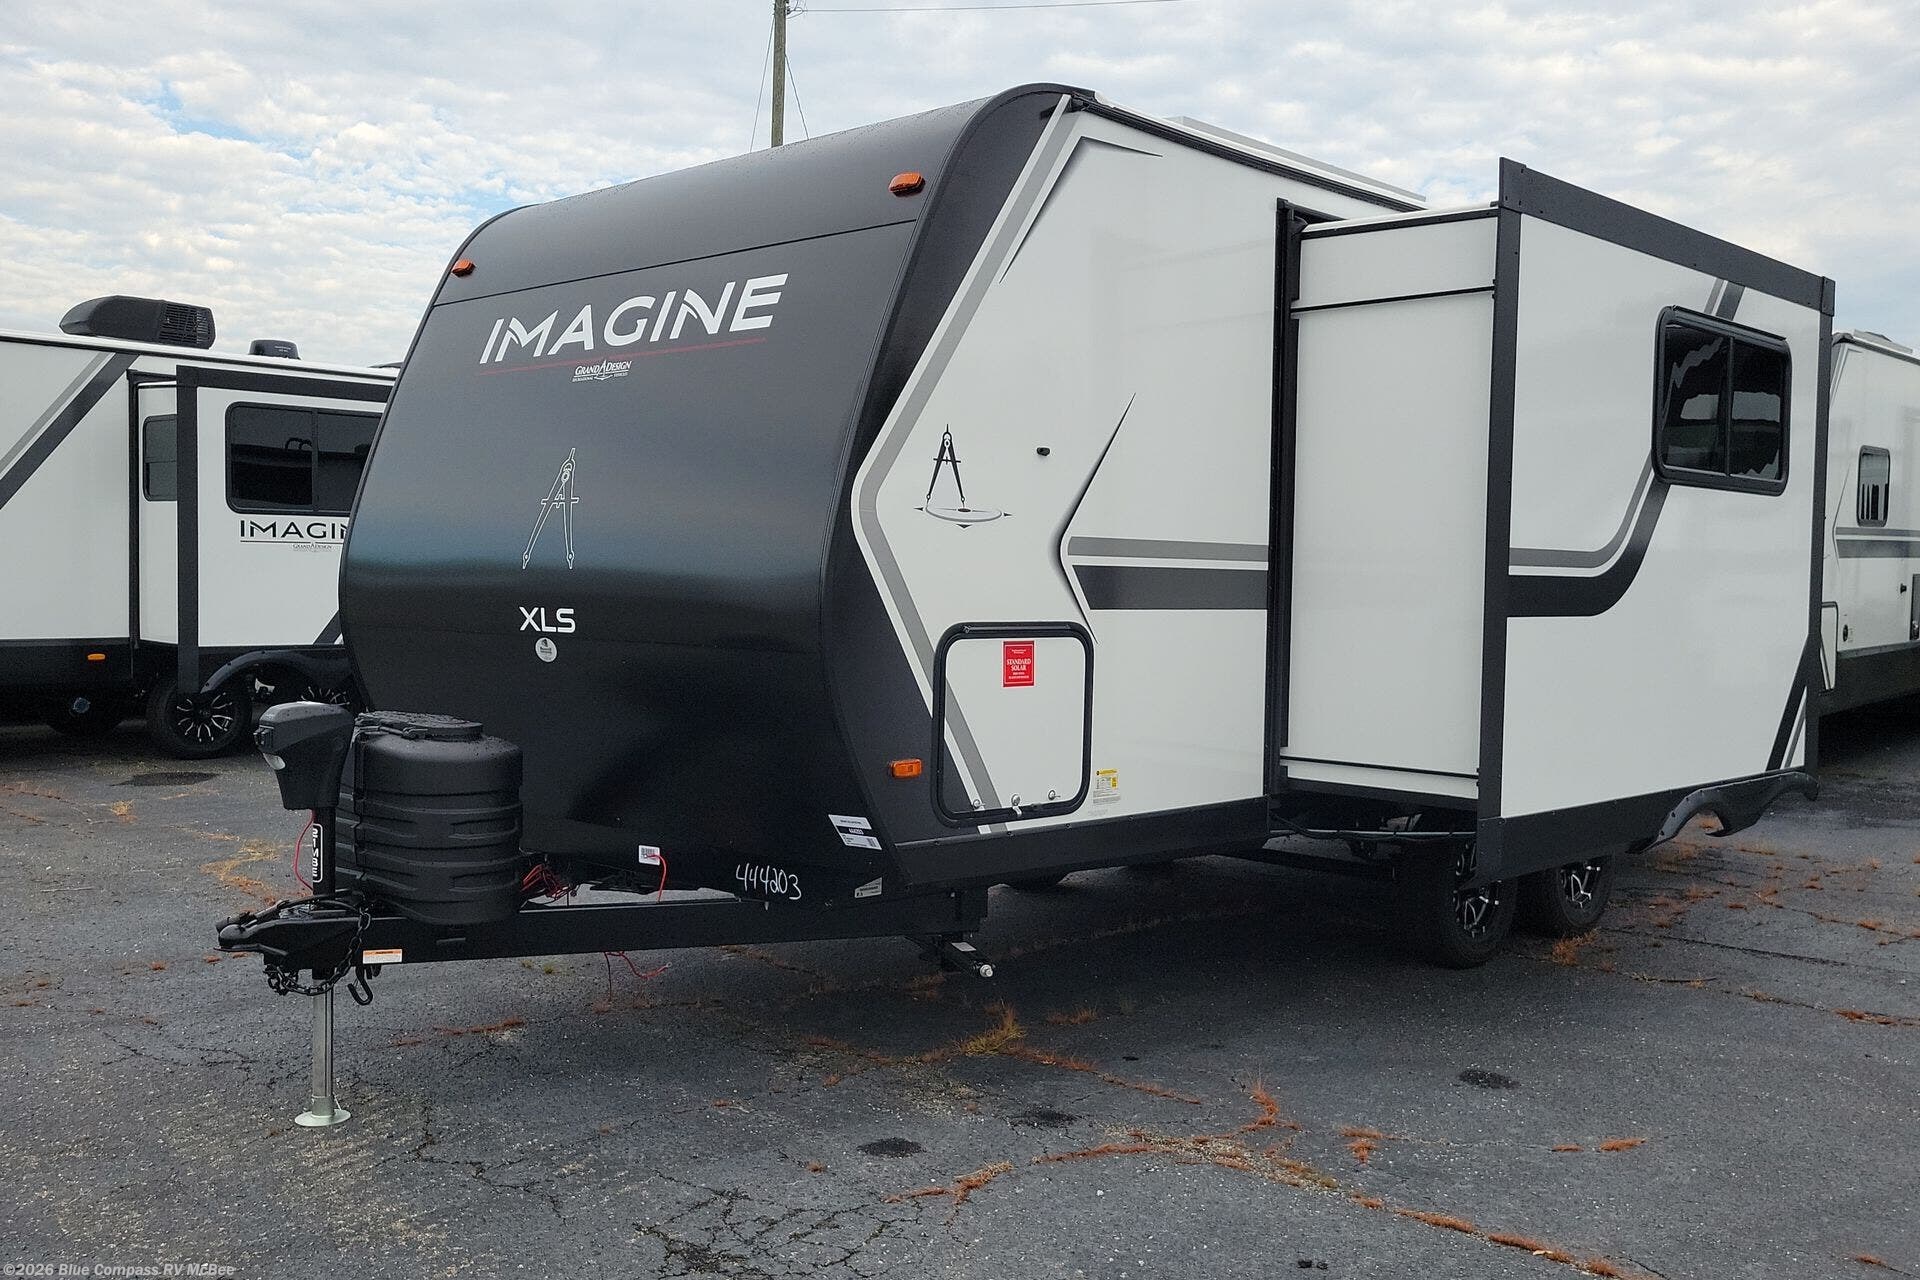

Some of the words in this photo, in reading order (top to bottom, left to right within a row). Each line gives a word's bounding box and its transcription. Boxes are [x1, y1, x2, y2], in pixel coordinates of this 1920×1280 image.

[479, 273, 789, 364] IMAGINE
[575, 365, 600, 376] GRAND
[606, 360, 632, 372] DESIGN
[519, 606, 576, 633] XLS
[1007, 658, 1032, 666] STANDARD
[735, 863, 802, 900] 444203
